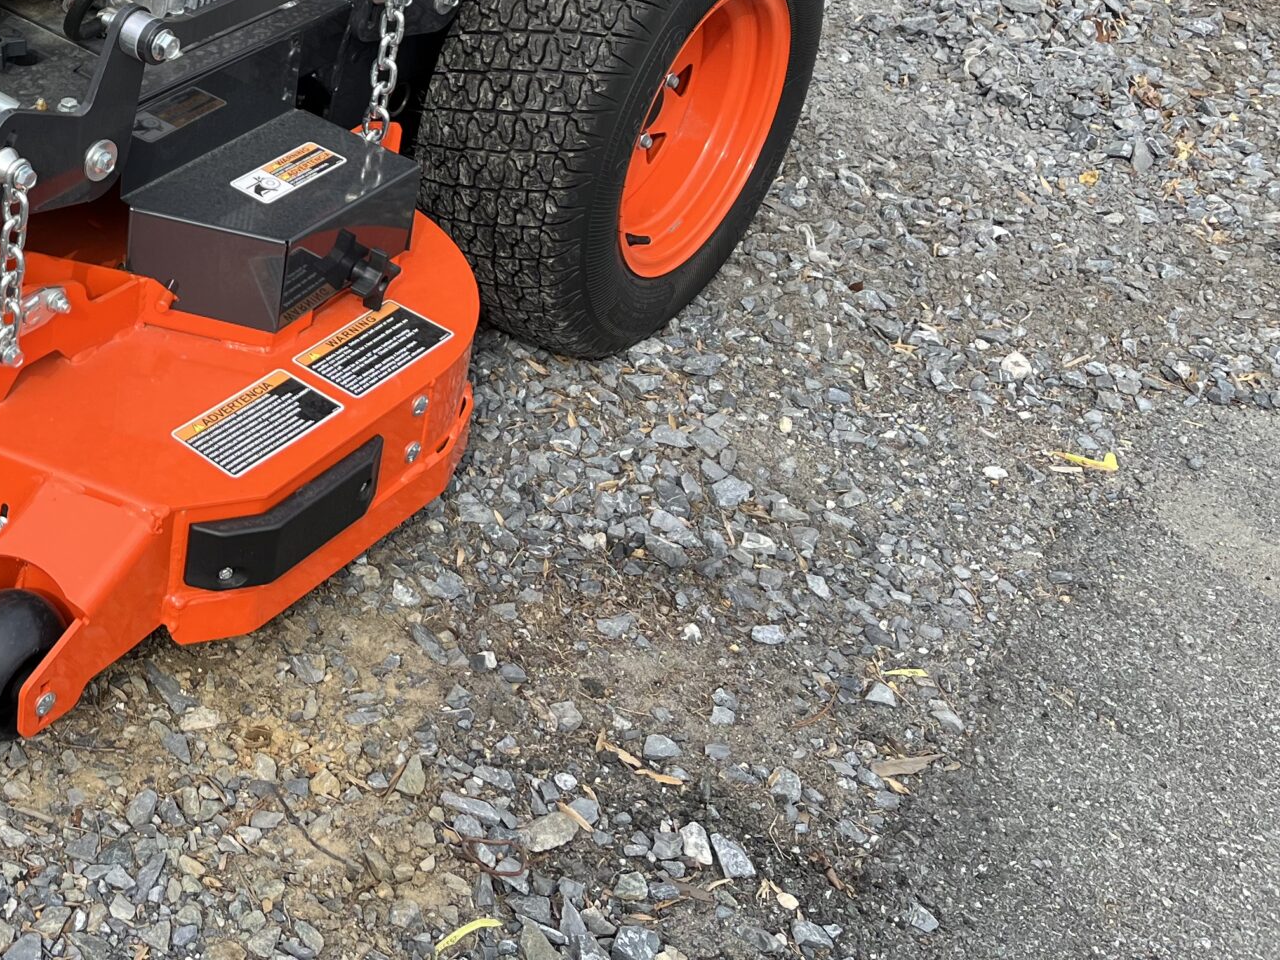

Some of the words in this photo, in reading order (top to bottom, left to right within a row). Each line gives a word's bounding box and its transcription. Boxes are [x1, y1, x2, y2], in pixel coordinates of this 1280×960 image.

[277, 147, 311, 167] WARNING
[326, 315, 377, 349] WARNING
[201, 380, 274, 428] ADVERTENCIA
